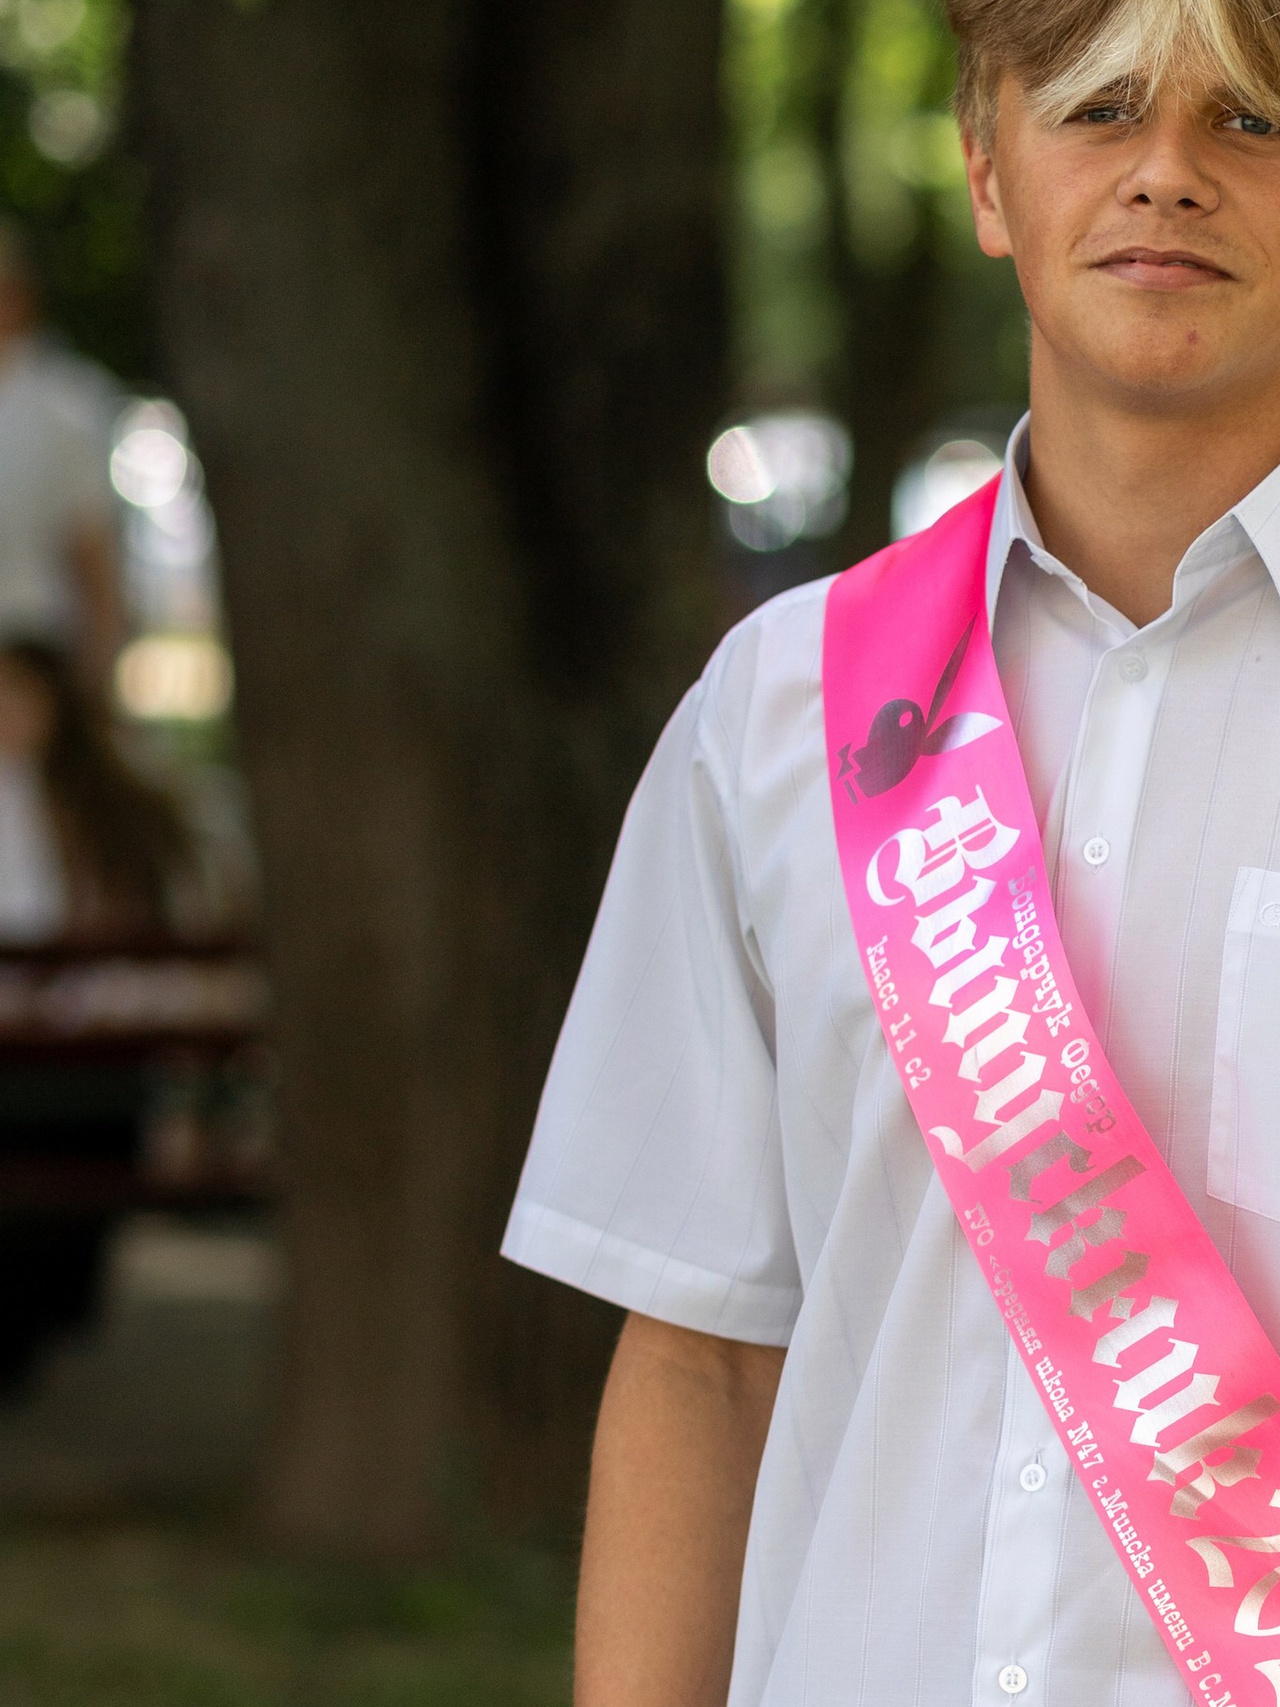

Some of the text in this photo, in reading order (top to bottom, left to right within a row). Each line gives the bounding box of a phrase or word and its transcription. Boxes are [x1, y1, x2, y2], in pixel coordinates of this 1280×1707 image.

[866, 935, 899, 1011] класс
[889, 1013, 918, 1053] 11
[1008, 866, 1117, 1134] Бондарчук Федор
[964, 1202, 995, 1246] ГУО
[1035, 1356, 1075, 1423] школа
[1146, 1578, 1195, 1652] имени
